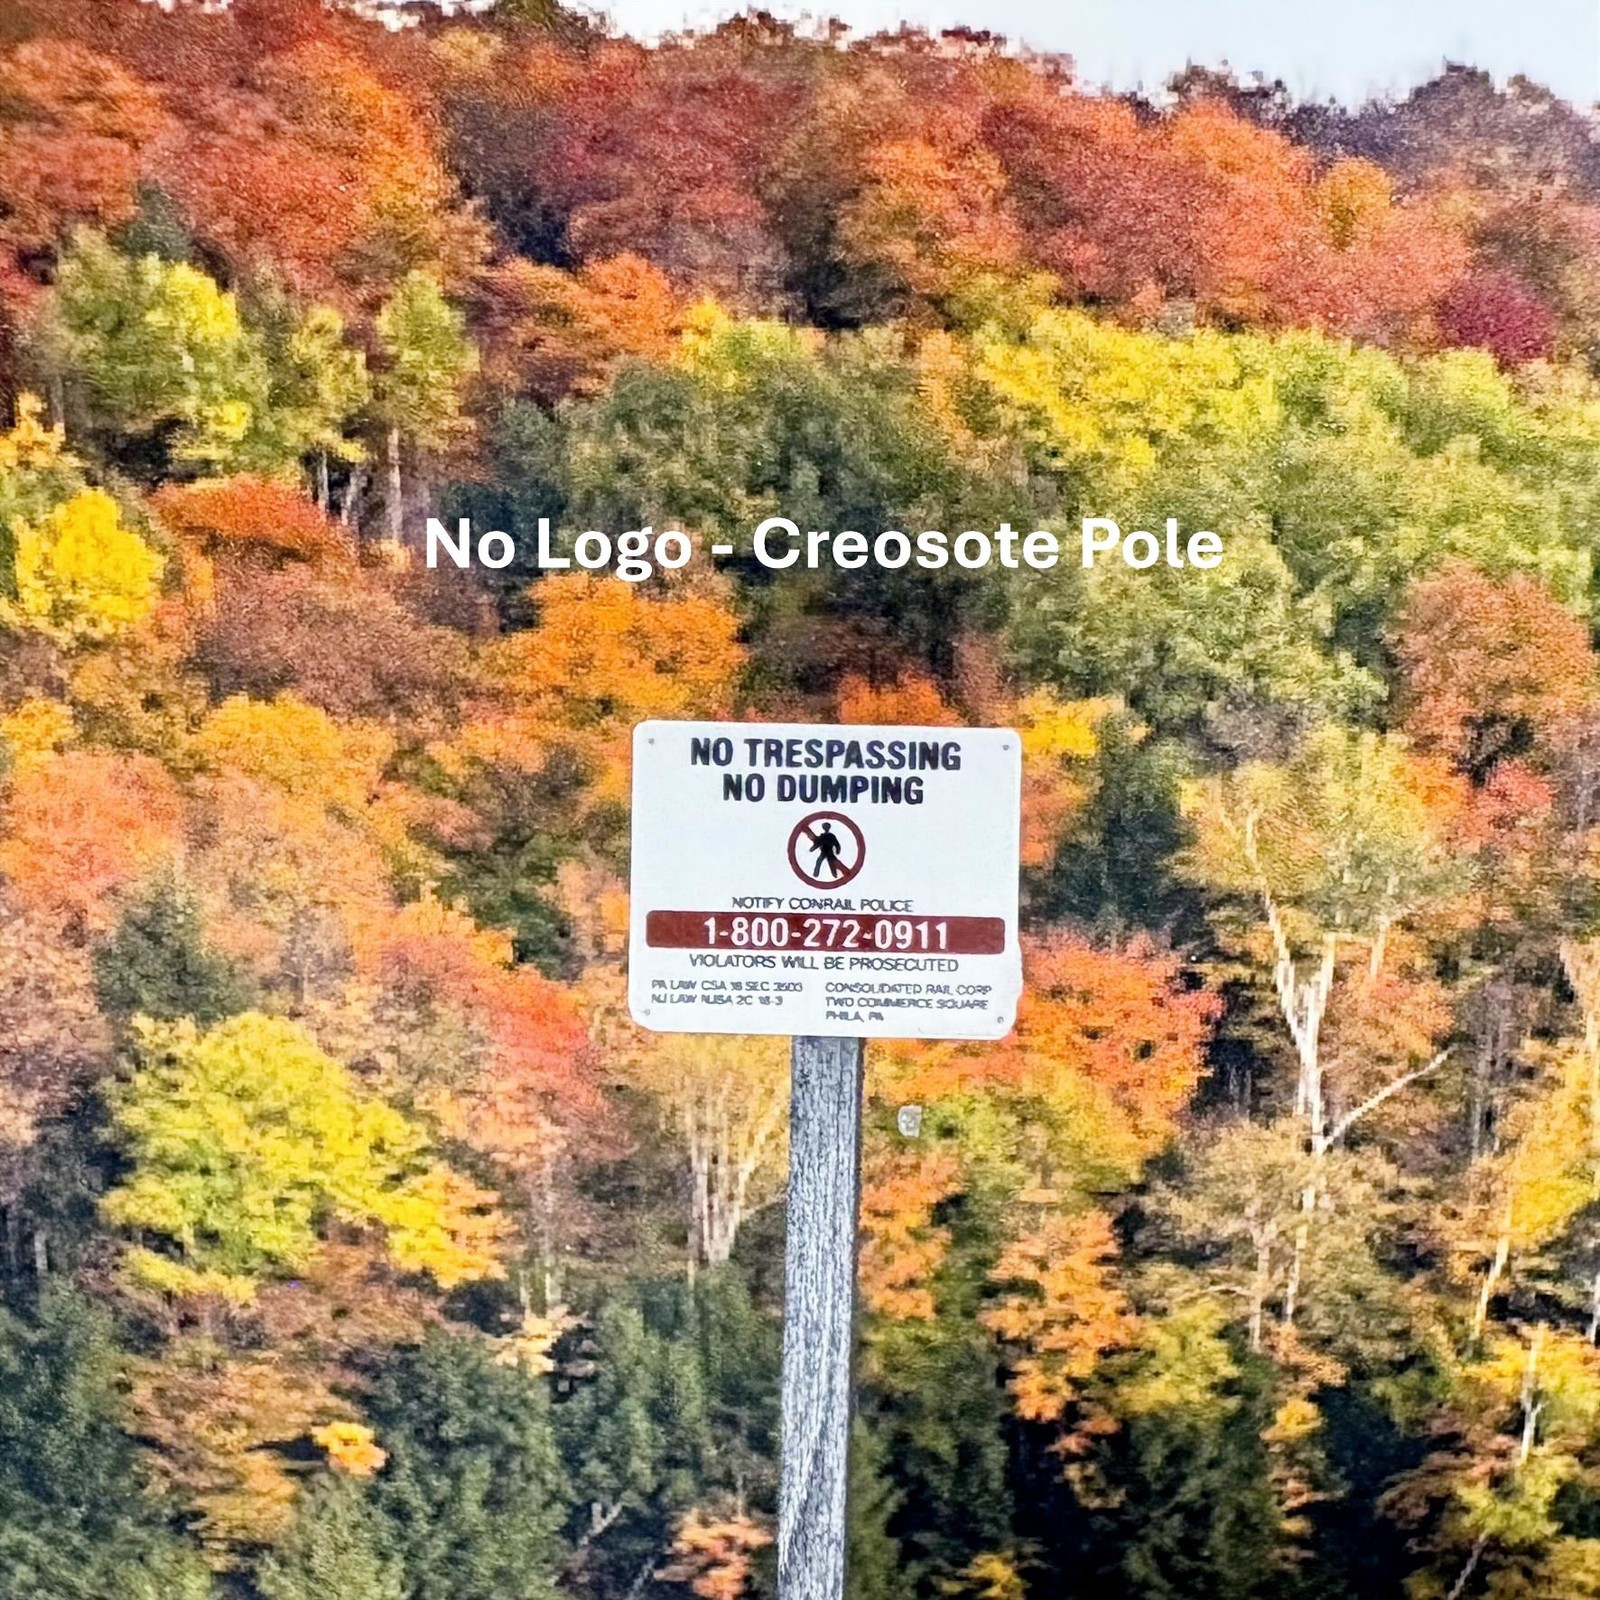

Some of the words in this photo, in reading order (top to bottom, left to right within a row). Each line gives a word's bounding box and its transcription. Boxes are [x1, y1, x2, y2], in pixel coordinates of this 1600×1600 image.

[691, 737, 733, 766] NO
[744, 738, 961, 770] TRESPASSING
[723, 773, 765, 802] NO
[777, 774, 923, 805] DUMPING
[732, 897, 784, 909] NOTIFY
[788, 897, 856, 911] CONRAIL
[860, 899, 913, 912] POLICE
[704, 917, 948, 949] 1-800-272-0911
[689, 954, 776, 968] VIOLATORS
[781, 956, 819, 970] WILL
[824, 956, 844, 970] BE
[849, 957, 959, 972] PROSECUTED
[652, 980, 667, 989] PA
[670, 980, 697, 990] LAW
[825, 982, 922, 994] CONSOLIDATED
[926, 984, 953, 995] RAIL
[826, 996, 854, 1007] TWO
[857, 997, 933, 1008] COMMERCE
[937, 999, 988, 1010] SQUARE
